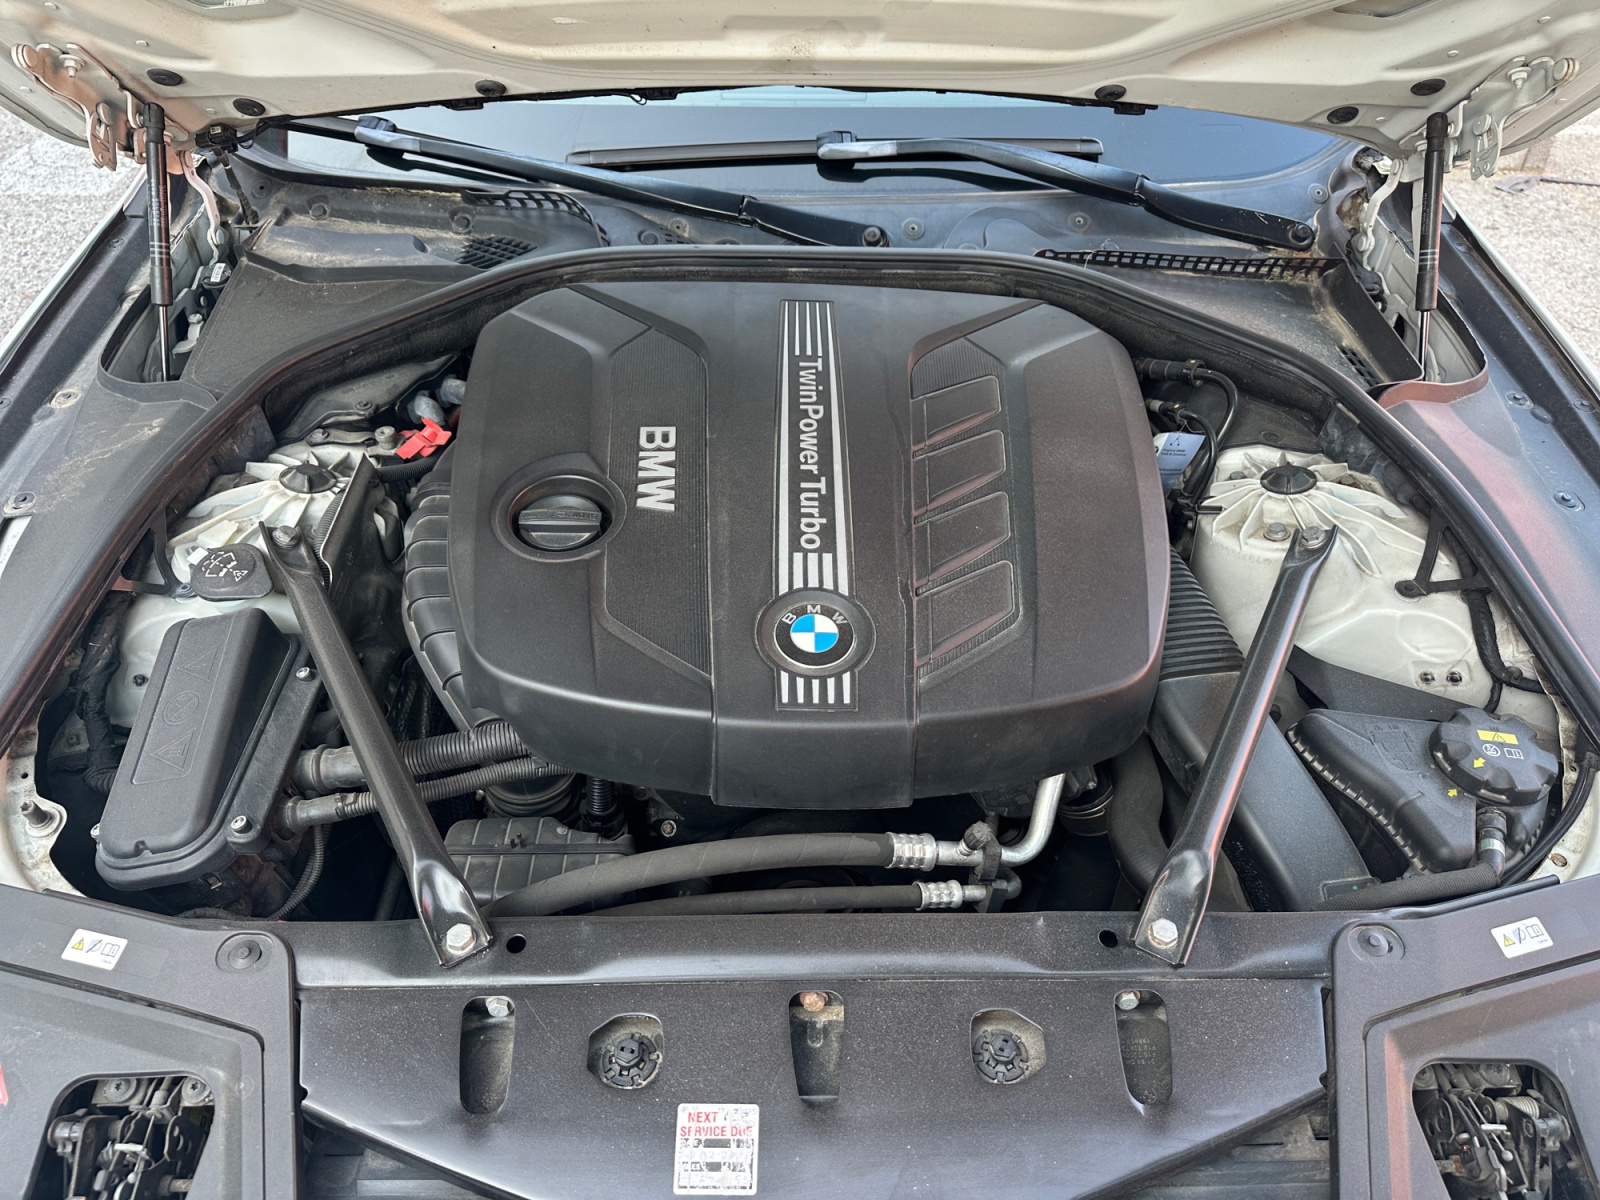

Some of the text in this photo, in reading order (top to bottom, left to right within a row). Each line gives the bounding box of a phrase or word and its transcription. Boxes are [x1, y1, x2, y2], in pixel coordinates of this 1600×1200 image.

[799, 358, 827, 549] TwinPower Turbo
[636, 426, 677, 512] BMW
[782, 604, 848, 625] BMW
[687, 1111, 719, 1123] NEXT
[680, 1126, 727, 1137] SERVICE
